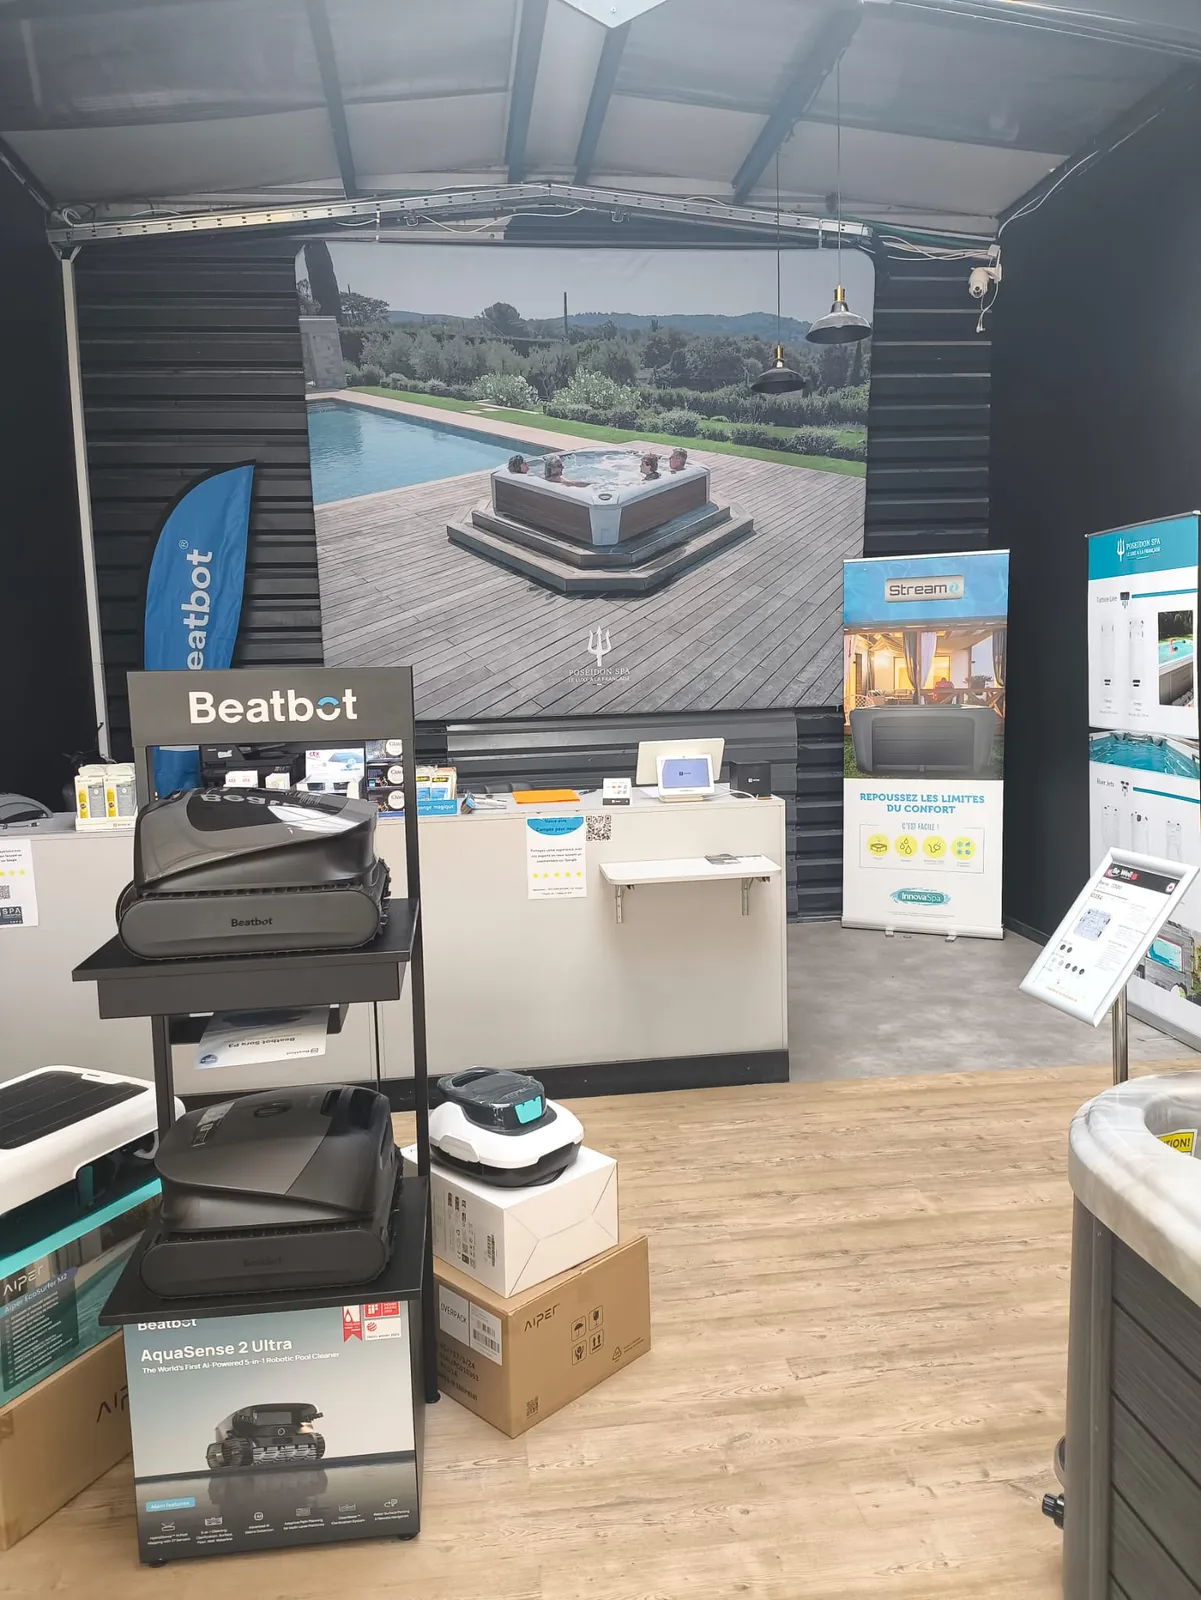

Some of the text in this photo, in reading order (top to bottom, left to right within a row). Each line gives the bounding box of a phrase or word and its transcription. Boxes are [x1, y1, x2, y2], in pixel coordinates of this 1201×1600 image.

[889, 584, 947, 596] Stream
[182, 549, 213, 670] eatbot
[189, 689, 357, 724] Beatbot
[860, 793, 985, 804] REPOUSSEZ LES LIMITES
[904, 805, 956, 814] CONFORT
[918, 823, 935, 831] FACILE
[902, 892, 941, 903] InnovaSpa
[231, 917, 272, 927] Beatbot
[4, 1273, 68, 1313] Aiper EcoSurfer M2
[441, 1302, 468, 1324] OVERPACK
[141, 1339, 293, 1364] AquaSense 2 Ultra
[158, 1364, 185, 1373] World's
[185, 1363, 201, 1371] First
[202, 1359, 244, 1369] AI-Powered
[245, 1357, 265, 1366] 5-in-1
[266, 1355, 294, 1364] Robotic
[295, 1353, 311, 1361] Pool
[312, 1351, 340, 1360] Cleaner
[97, 1385, 129, 1424] AIP
